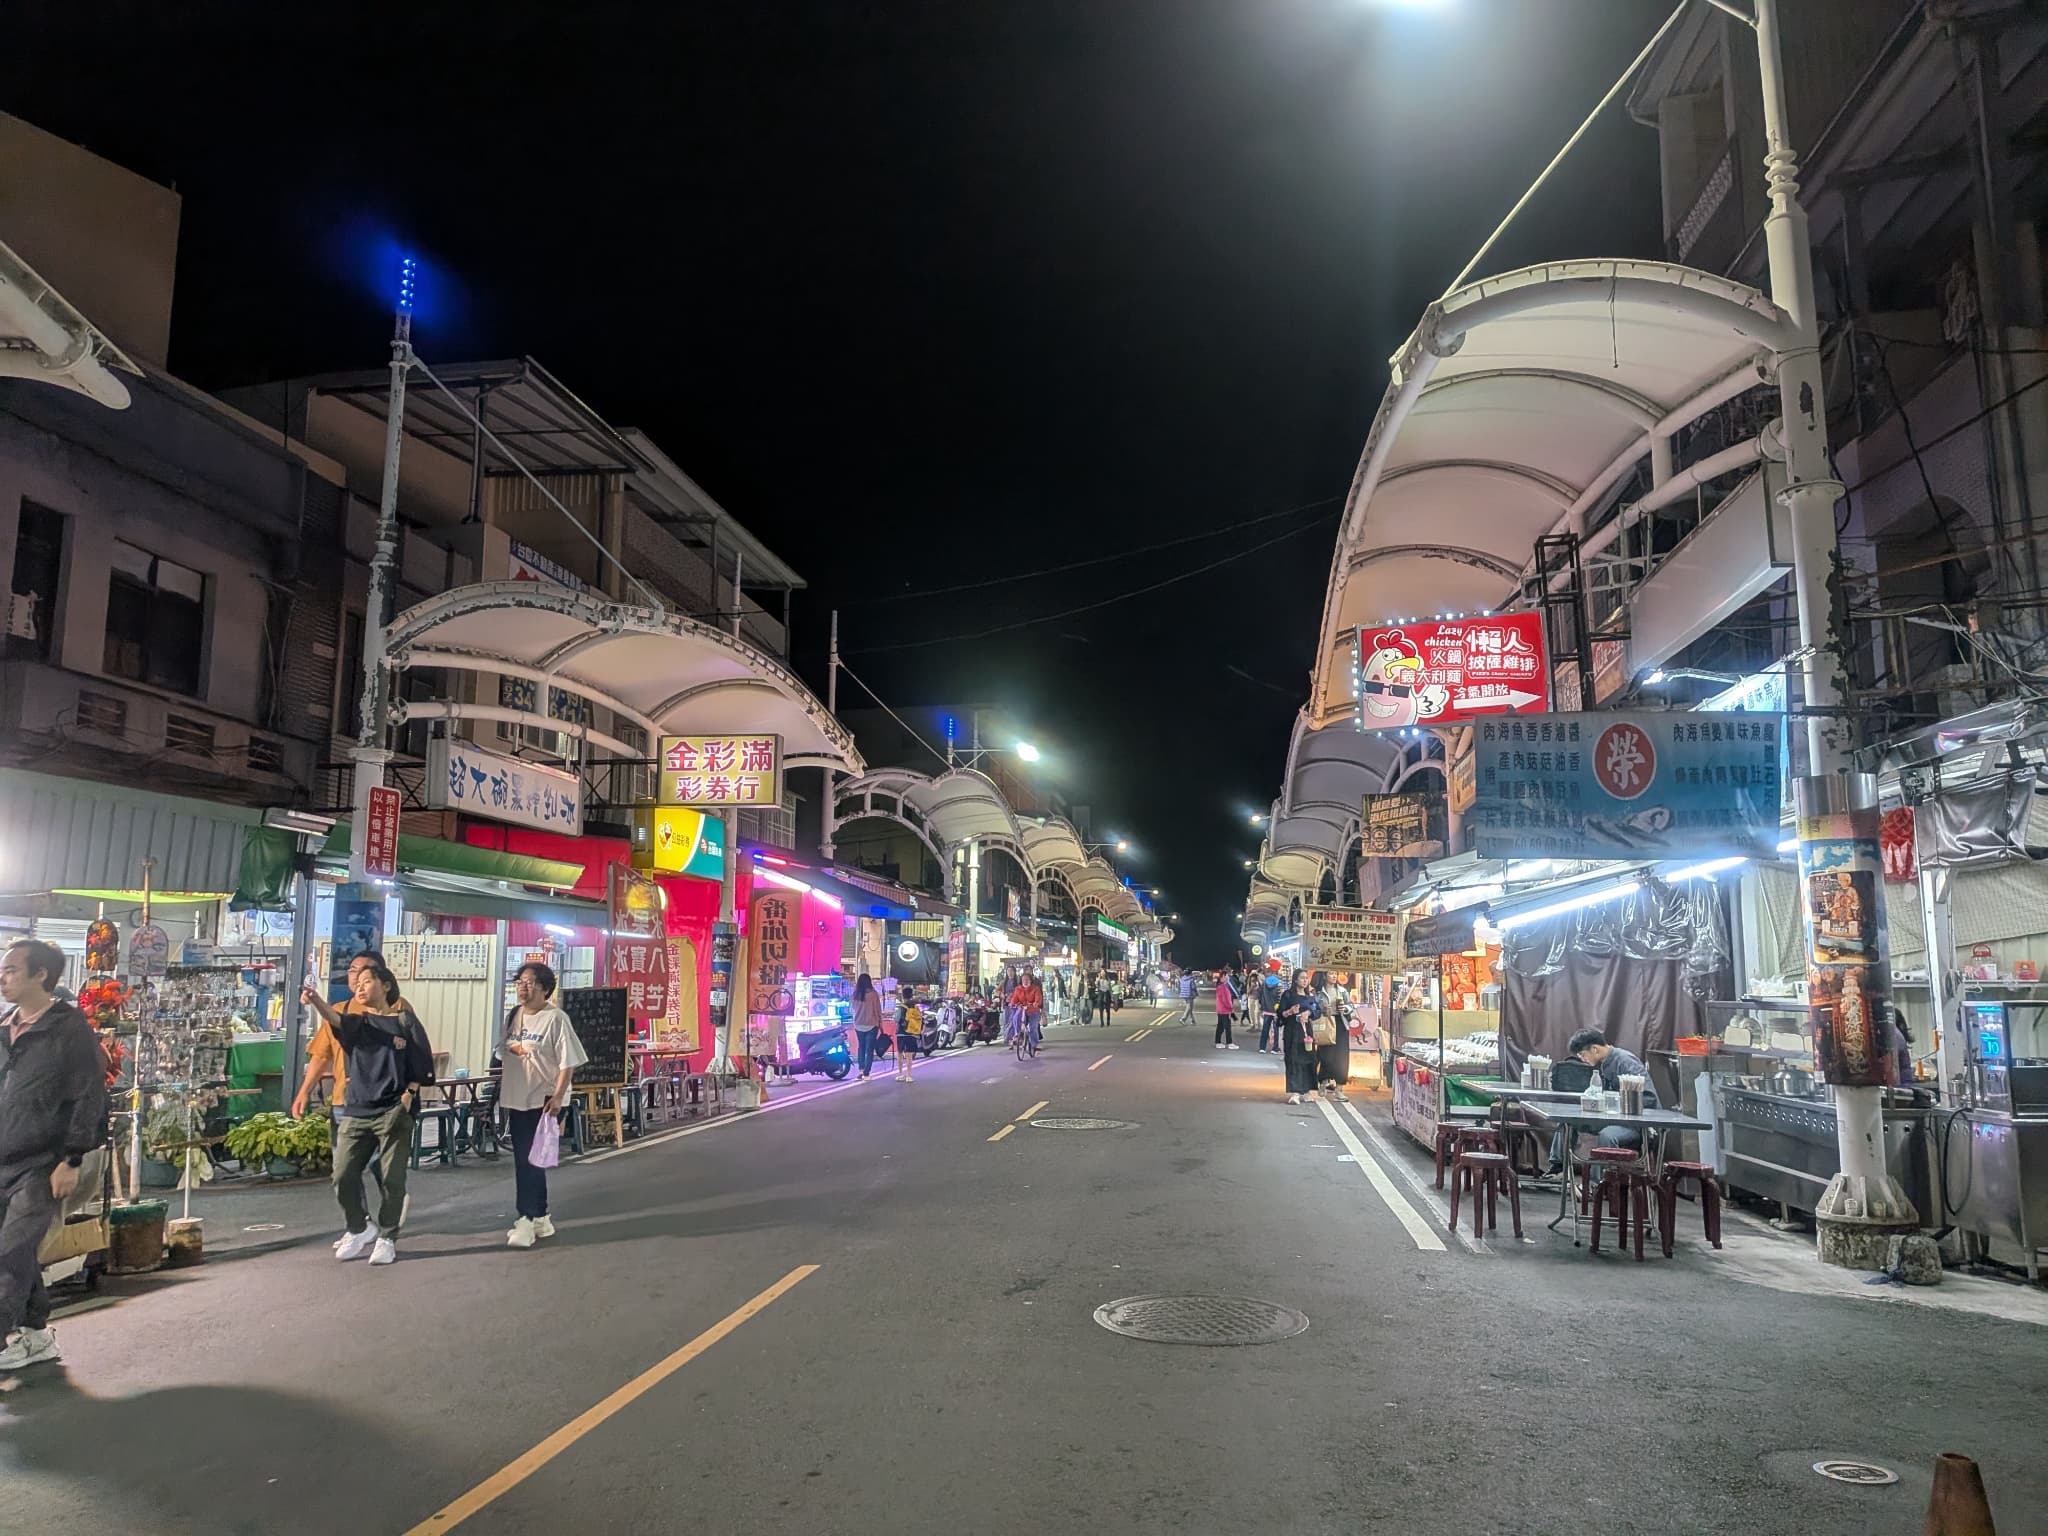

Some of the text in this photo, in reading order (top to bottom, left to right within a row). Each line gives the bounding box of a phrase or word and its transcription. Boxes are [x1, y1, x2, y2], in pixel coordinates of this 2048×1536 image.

[1437, 625, 1463, 637] Lazy
[1425, 636, 1463, 647] chicken
[1466, 629, 1532, 654] 懶人
[1431, 650, 1463, 665] 火鍋
[1401, 669, 1463, 684] 義大利麵
[1454, 684, 1510, 699] 冷氣開放
[665, 740, 773, 772] 金彩滿
[1606, 731, 1645, 790] 榮
[676, 776, 760, 801] 彩券行
